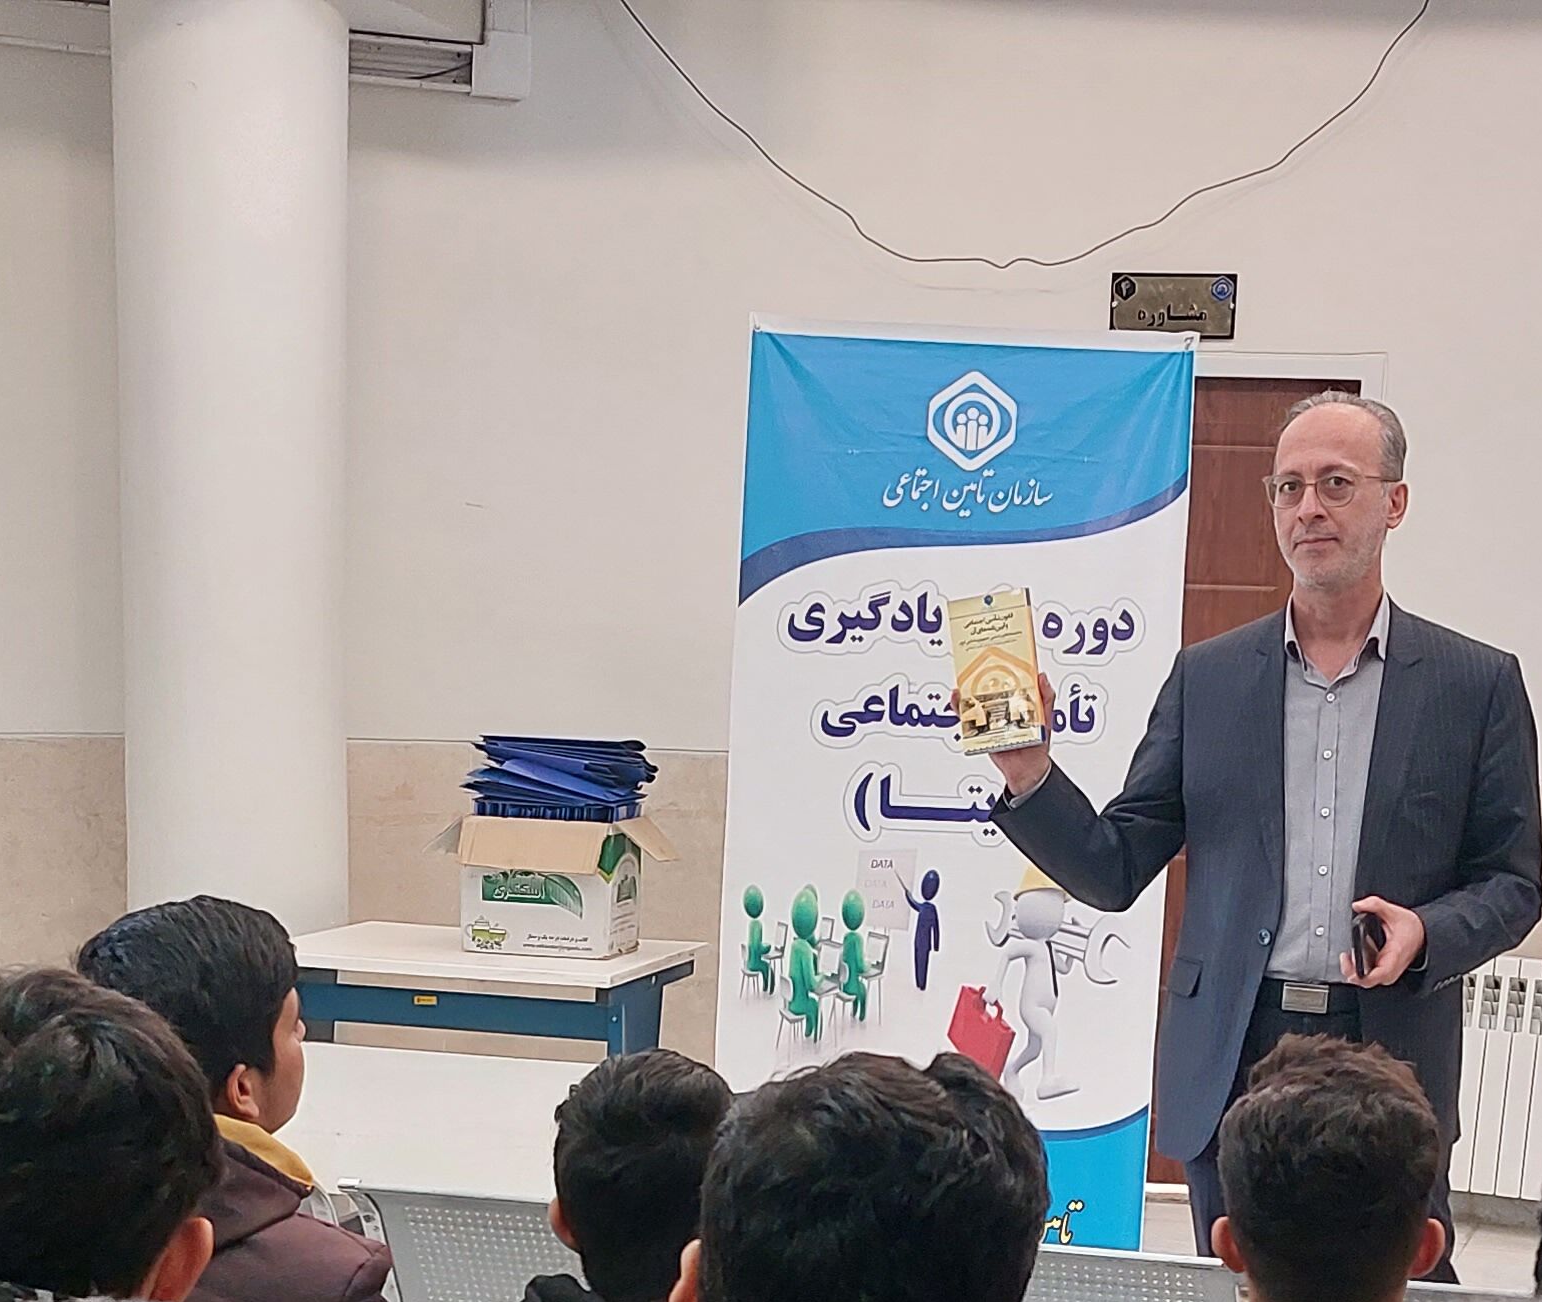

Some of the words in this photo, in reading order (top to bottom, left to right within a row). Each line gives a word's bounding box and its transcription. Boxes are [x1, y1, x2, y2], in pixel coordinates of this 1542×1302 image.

[1137, 303, 1208, 327] مشاوره
[882, 467, 941, 512] اجتماعی
[986, 478, 1054, 513] سازمان
[787, 590, 943, 647] یادگیری
[1041, 608, 1135, 656] دوره
[820, 684, 962, 744] جتماعی
[1050, 682, 1098, 735] تأم
[870, 858, 894, 869] DATA
